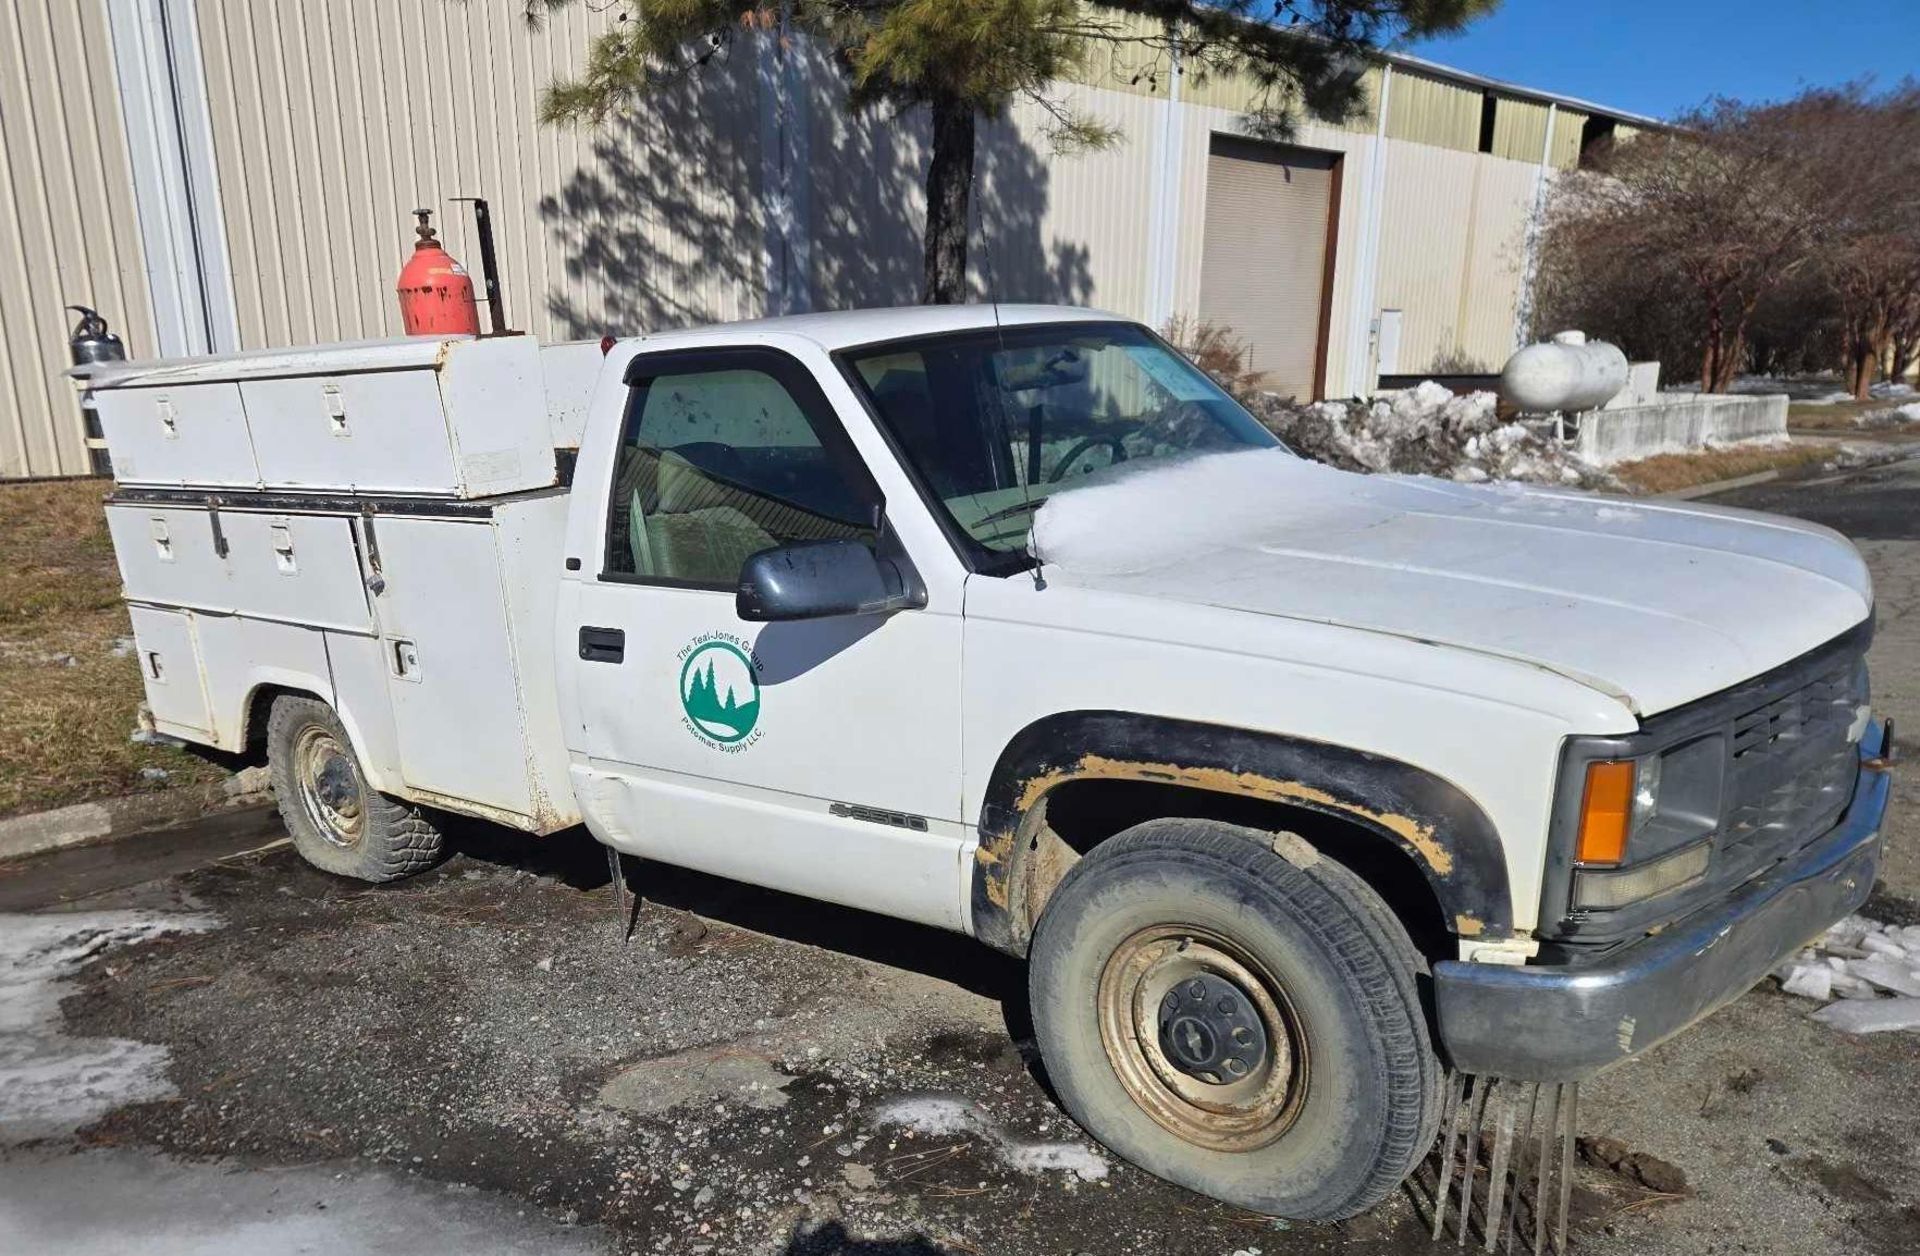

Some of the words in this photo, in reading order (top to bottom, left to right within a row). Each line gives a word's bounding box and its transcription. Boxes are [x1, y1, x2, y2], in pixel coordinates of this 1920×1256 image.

[676, 645, 692, 661] The
[692, 630, 740, 646] Teal-Jones
[741, 640, 764, 672] Group
[681, 716, 716, 750] Potomac
[718, 742, 748, 755] Supply
